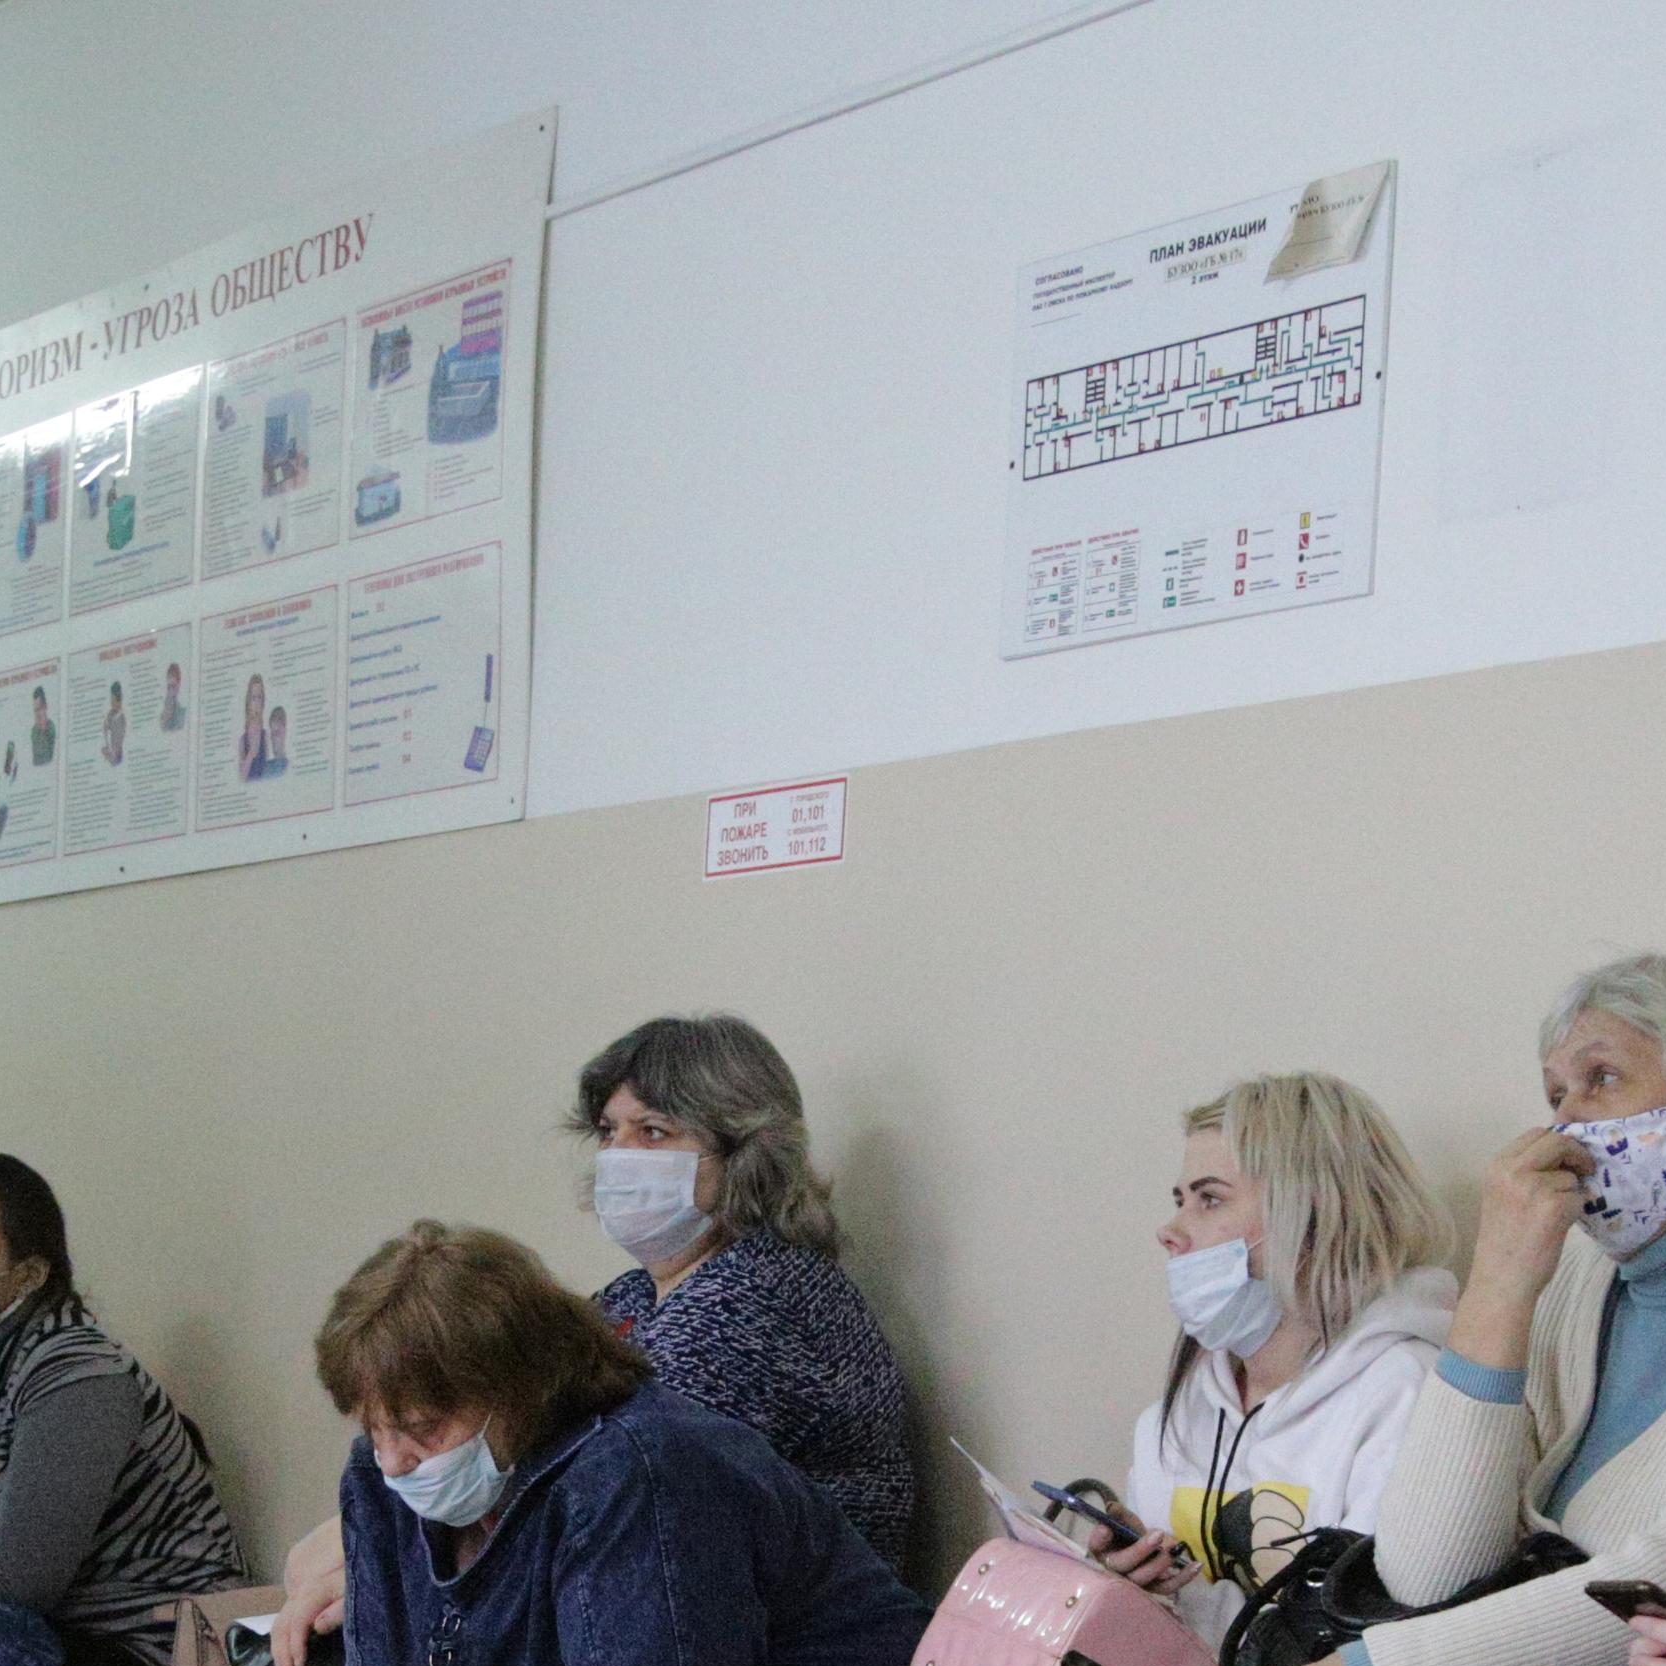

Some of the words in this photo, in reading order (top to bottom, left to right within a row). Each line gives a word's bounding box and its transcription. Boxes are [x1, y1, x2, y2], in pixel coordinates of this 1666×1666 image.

[1149, 241, 1184, 264] ПЛАН
[1188, 217, 1267, 252] ЭВАКУАЦИИ
[102, 287, 200, 361] УГРОЗА
[210, 213, 376, 318] ОБЩЕСТВУ
[734, 801, 757, 819] ПРИ
[792, 804, 825, 825] 01,101
[720, 822, 768, 843] ПОЖАРЕ
[717, 845, 769, 867] ЗВОНИТЬ
[788, 836, 827, 857] 101,112
